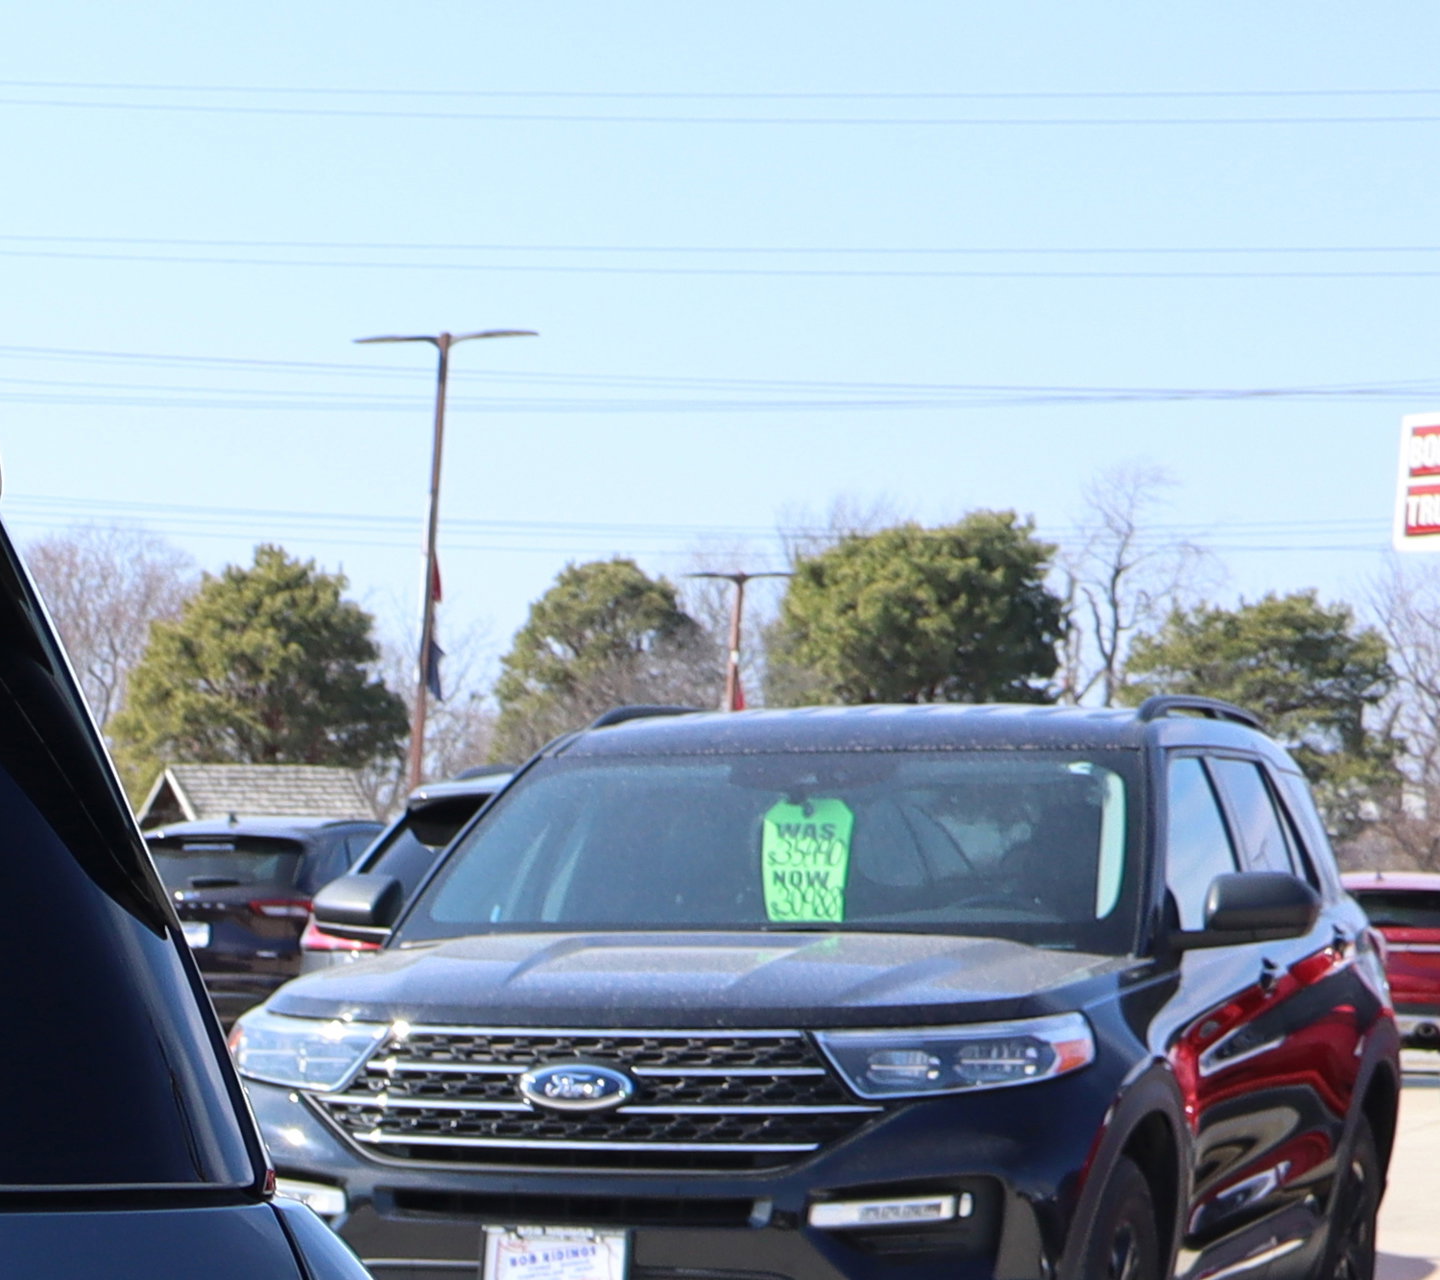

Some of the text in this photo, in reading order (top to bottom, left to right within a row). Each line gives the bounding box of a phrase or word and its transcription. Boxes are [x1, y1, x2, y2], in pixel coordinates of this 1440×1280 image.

[1409, 435, 1440, 467] BO
[778, 823, 836, 840] WAS
[773, 871, 830, 887] NOW
